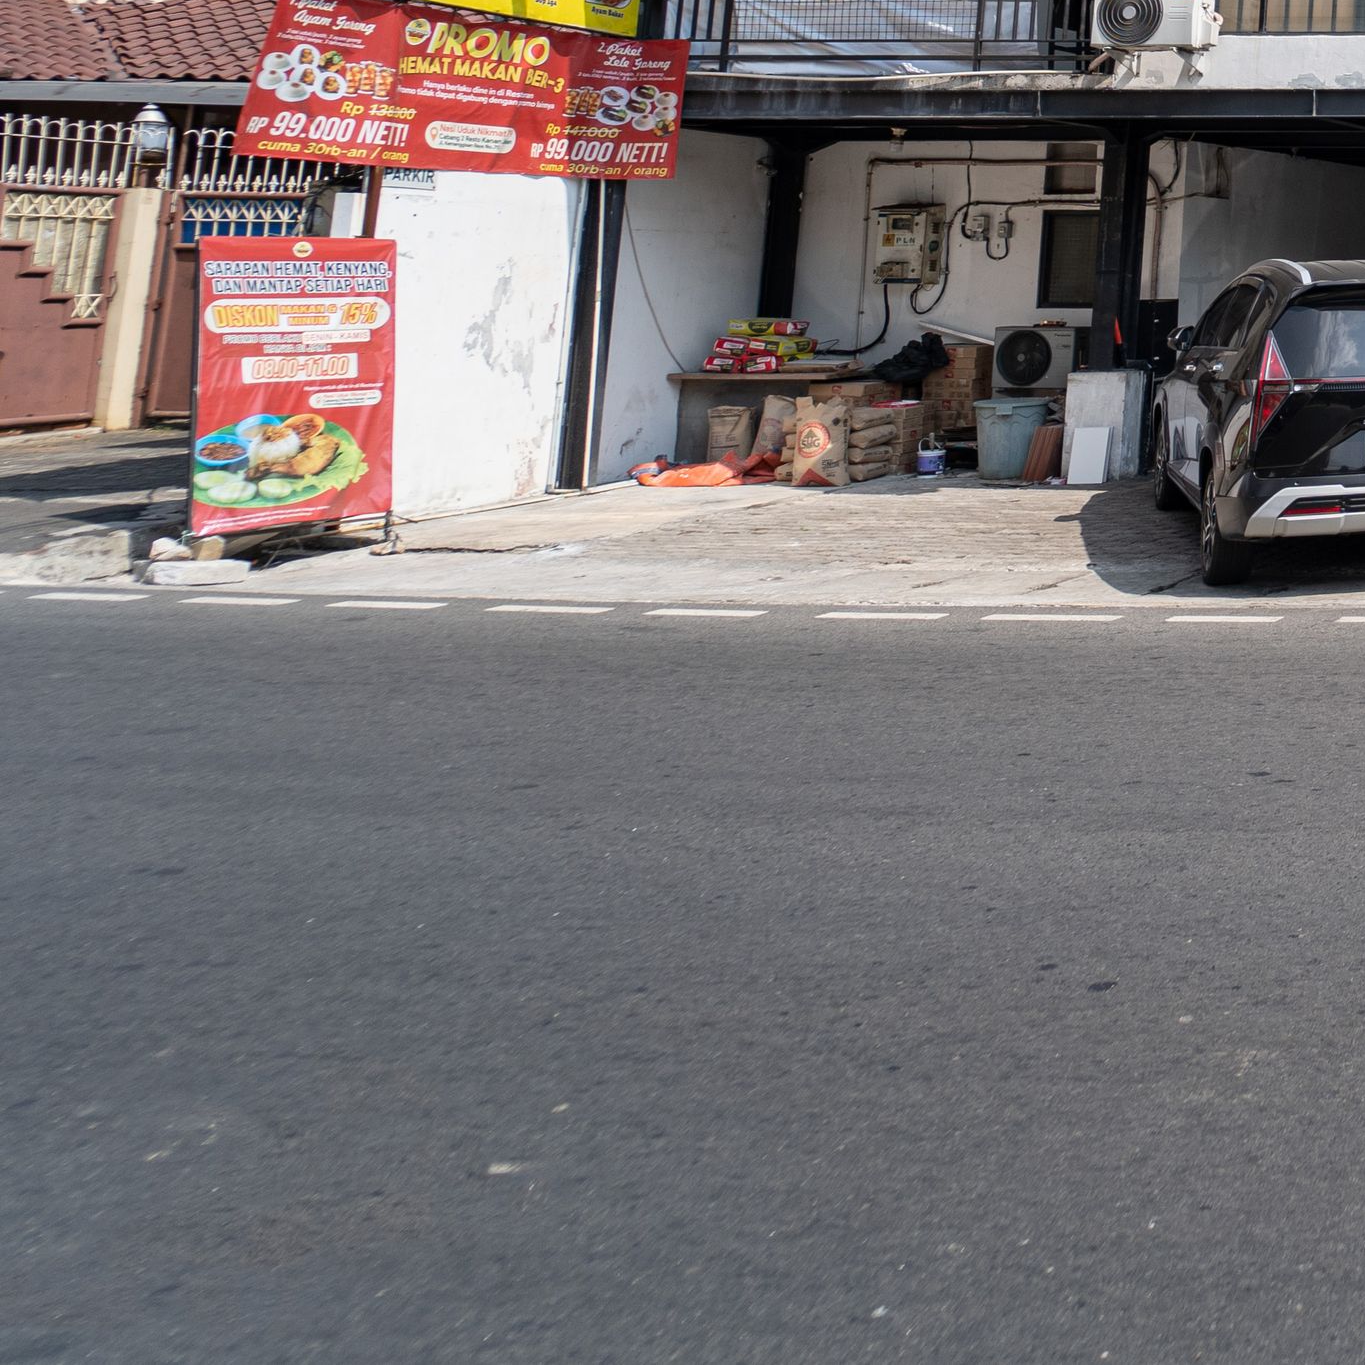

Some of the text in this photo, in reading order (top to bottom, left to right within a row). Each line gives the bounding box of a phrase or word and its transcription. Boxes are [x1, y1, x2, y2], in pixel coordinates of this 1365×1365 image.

[591, 5, 607, 16] Ayam
[293, 9, 333, 27] Ayam
[331, 15, 376, 36] Goreng
[426, 21, 551, 67] PROMO
[603, 55, 671, 71] Lele Goreng
[398, 55, 565, 94] HEMAT MAKAN BER-3
[340, 101, 364, 116] Rp
[245, 111, 410, 147] RP 99.000 NETT!
[440, 124, 457, 133] Nasi
[457, 125, 476, 134] Uduk
[545, 123, 621, 138] Rp 147.000
[257, 140, 301, 153] cuma
[303, 142, 367, 158] 30rb-an
[381, 151, 410, 164] orang
[530, 138, 669, 163] RP 99.000 NETT!
[383, 167, 435, 183] PARKIR
[539, 163, 564, 172] cuma
[566, 162, 621, 174] 30rb-an
[633, 166, 668, 177] orang
[896, 236, 916, 244] PLN
[204, 261, 392, 277] SARAPAN HEMAT, KENYANG,
[213, 278, 389, 294] DAN MANTAP SETIAP HARI
[212, 302, 379, 328] DISKON 15%
[280, 304, 325, 315] MAKAN
